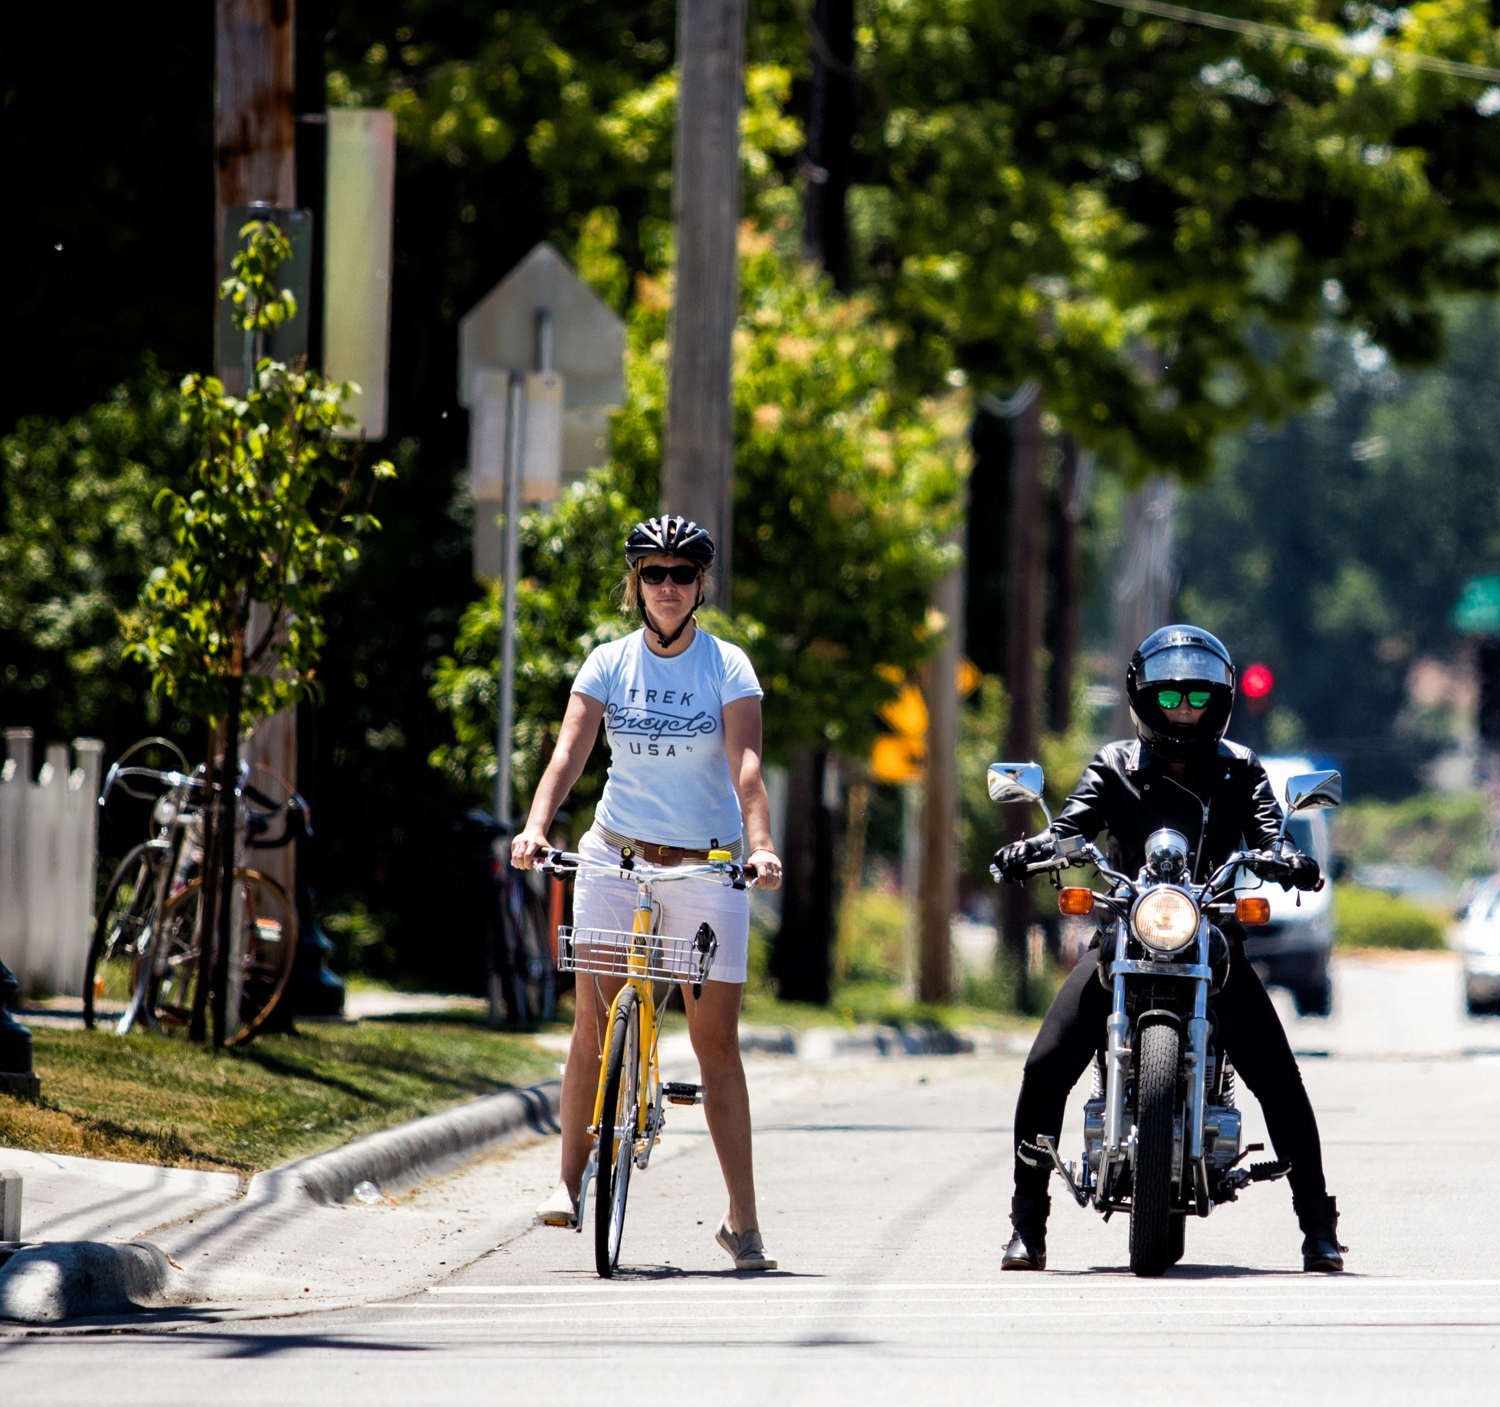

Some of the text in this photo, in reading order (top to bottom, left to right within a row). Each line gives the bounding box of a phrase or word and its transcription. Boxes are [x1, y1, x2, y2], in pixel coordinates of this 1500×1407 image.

[629, 689, 694, 706] TREK
[607, 702, 717, 741] Bicycle
[629, 742, 676, 757] USA
